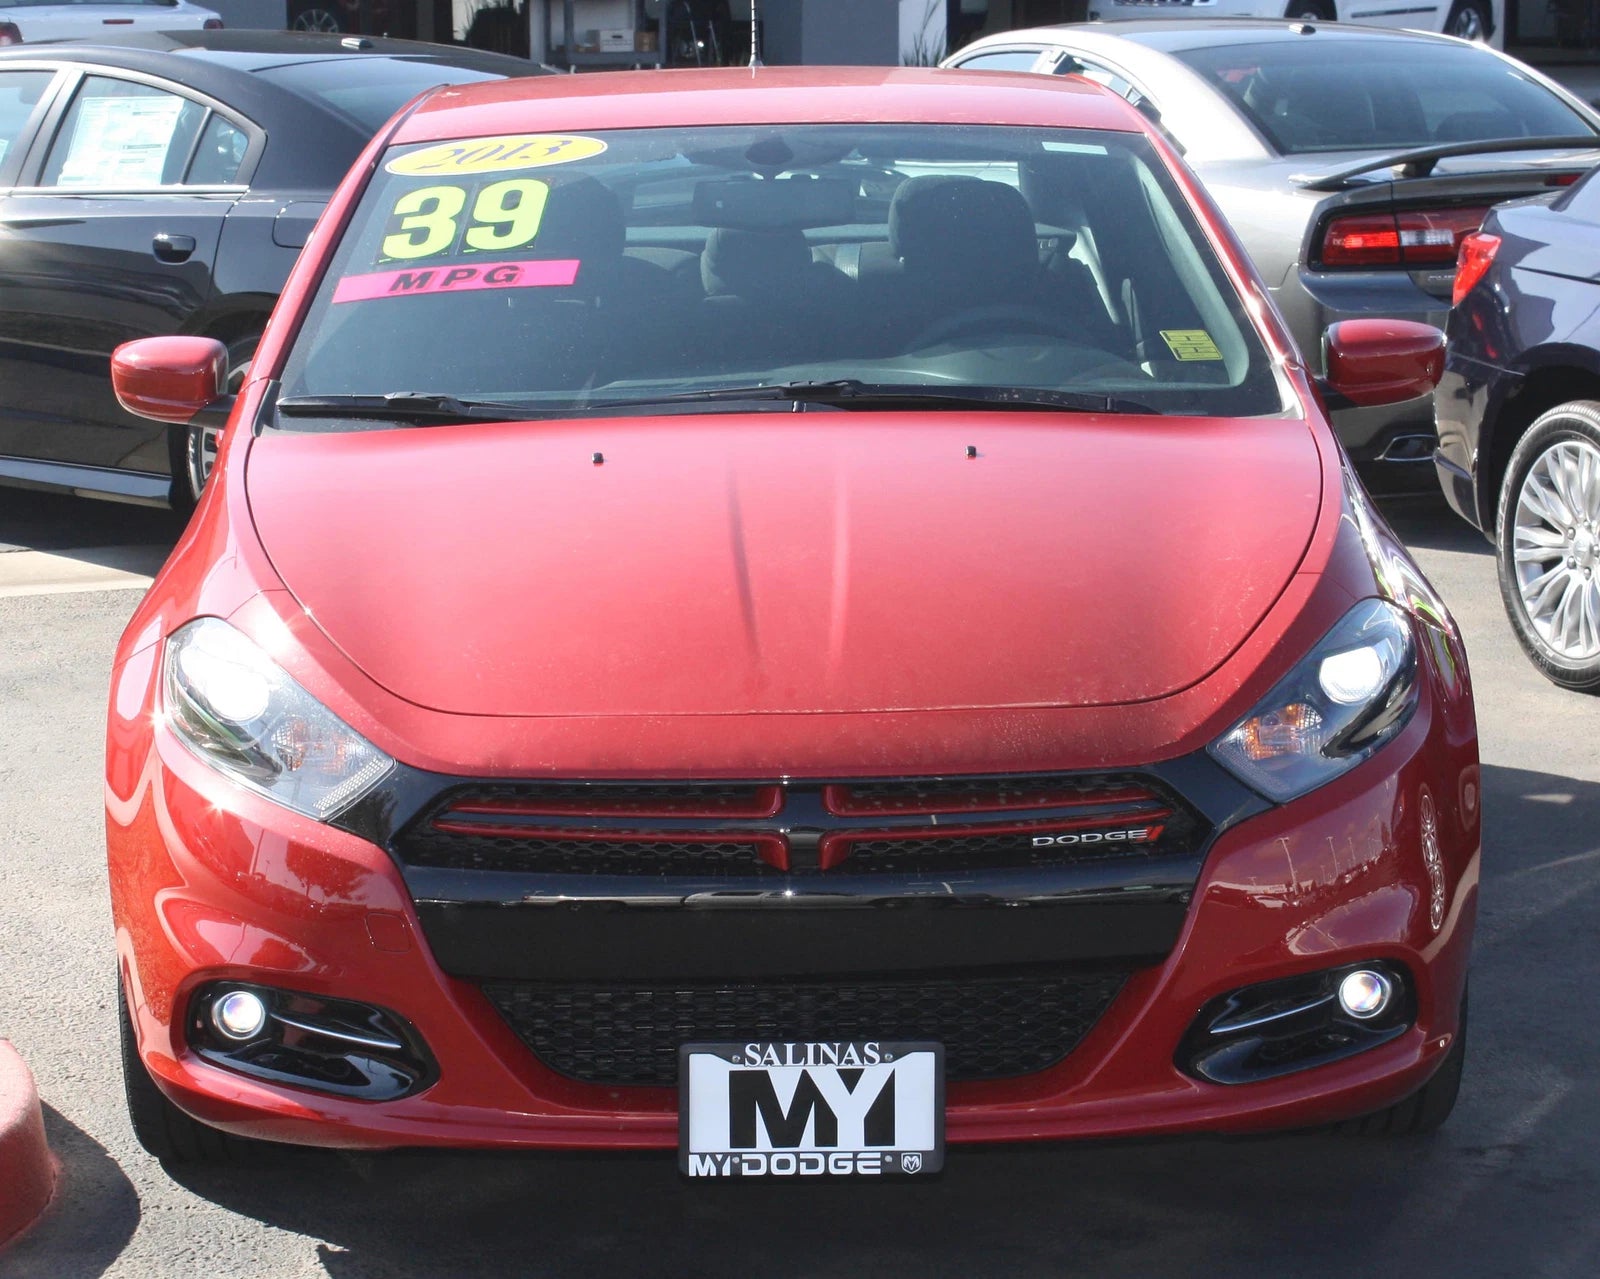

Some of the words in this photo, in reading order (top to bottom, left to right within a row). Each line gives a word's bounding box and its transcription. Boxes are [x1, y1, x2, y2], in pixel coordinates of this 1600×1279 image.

[414, 139, 574, 171] 2013
[382, 179, 549, 259] 39
[388, 264, 523, 293] MPG
[1032, 829, 1148, 847] DODGE
[744, 1042, 881, 1067] SALINAS
[728, 1067, 896, 1149] MY
[688, 1154, 731, 1176] MY
[741, 1152, 881, 1176] DODGE
